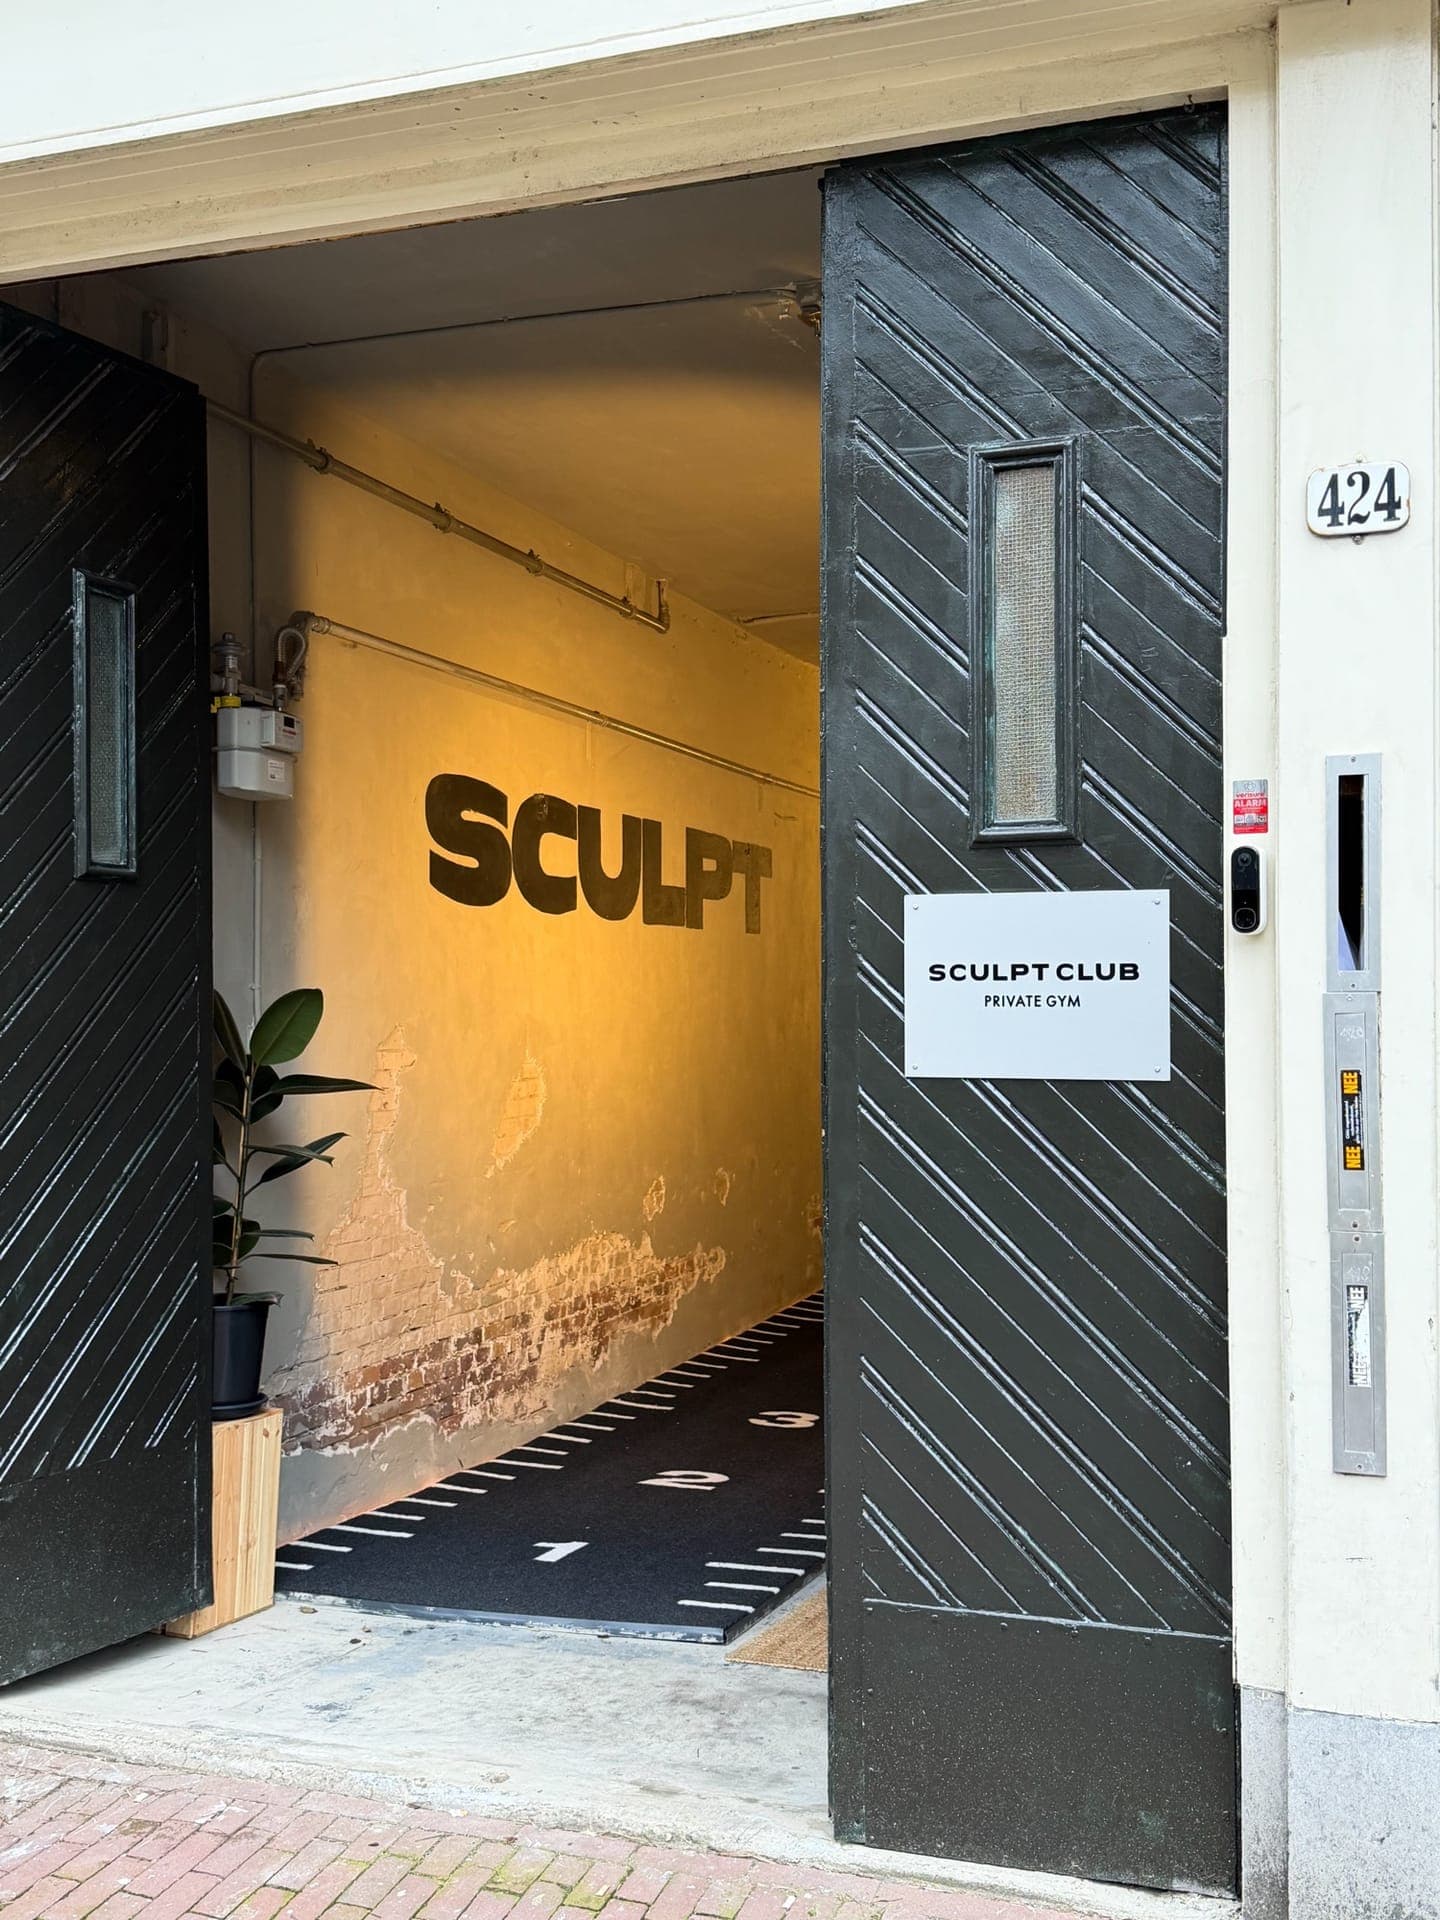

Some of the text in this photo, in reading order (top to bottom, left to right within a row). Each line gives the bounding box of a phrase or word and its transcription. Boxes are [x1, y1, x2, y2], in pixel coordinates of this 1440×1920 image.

[1317, 467, 1402, 528] 424
[1234, 799, 1266, 807] ALARM
[425, 773, 773, 934] SCULPT
[928, 962, 1141, 982] SCULPT CLUB
[984, 994, 1081, 1008] PRIVATE GYM
[1343, 1072, 1358, 1094] NEE
[1345, 1146, 1361, 1168] NEE
[1350, 1287, 1365, 1310] NEE
[748, 1411, 820, 1428] 3
[637, 1470, 730, 1491] 2
[533, 1541, 590, 1562] 1
